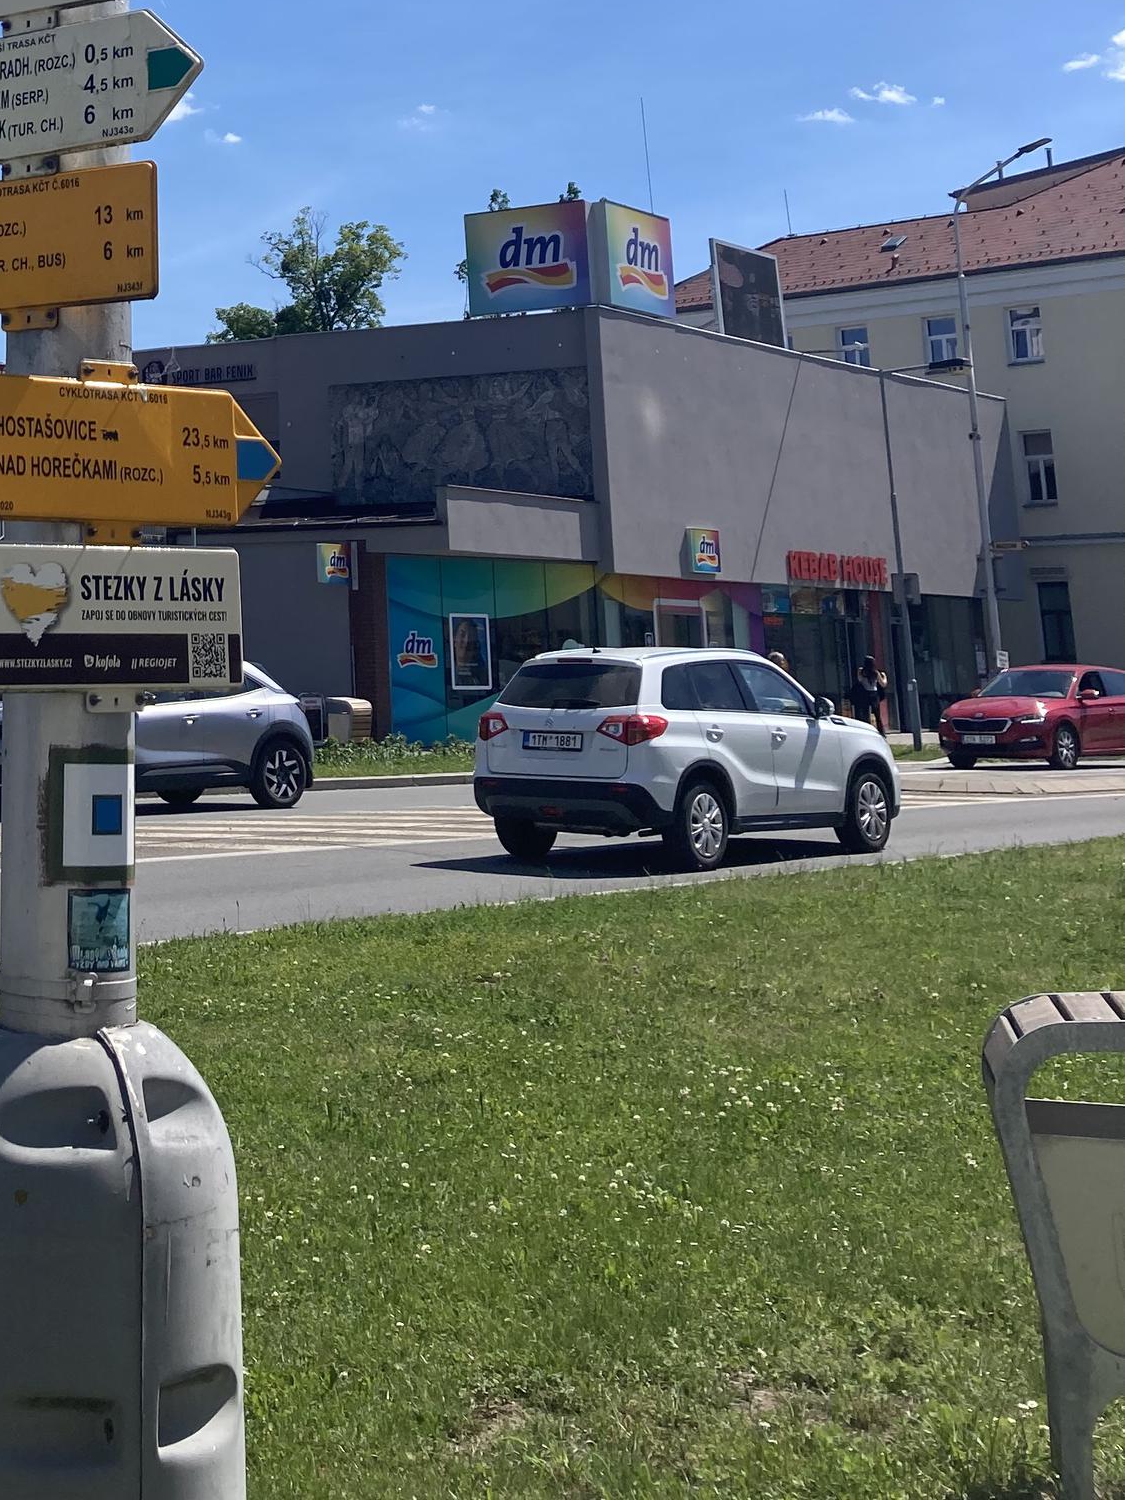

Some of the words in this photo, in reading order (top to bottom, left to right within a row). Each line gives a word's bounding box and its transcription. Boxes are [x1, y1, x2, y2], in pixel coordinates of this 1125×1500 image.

[7, 37, 36, 51] TRASA
[38, 33, 57, 45] KČT
[0, 57, 32, 81] RADH.
[34, 53, 76, 77] (ROZC.)
[84, 44, 108, 64] 0,5
[112, 44, 134, 59] km
[11, 88, 49, 110] (SERP.)
[83, 74, 108, 94] 4,5
[112, 74, 134, 90] km
[8, 122, 38, 142] (TUR.
[40, 116, 64, 135] CH.)
[84, 104, 95, 124] 6
[112, 106, 134, 121] km
[32, 180, 50, 193] KČT
[94, 205, 113, 225] 13
[126, 208, 143, 221] km
[38, 252, 66, 269] BUS)
[103, 241, 112, 260] 6
[126, 245, 144, 258] km
[499, 226, 561, 269] dm
[626, 227, 660, 272] dm
[172, 369, 201, 383] SPORT
[204, 367, 222, 380] BAR
[182, 427, 210, 448] 23,5
[213, 436, 229, 449] km
[31, 452, 118, 481] HOREČKAMI
[120, 466, 164, 486] (ROZC.)
[193, 464, 212, 486] 5,5
[214, 473, 231, 486] km
[699, 536, 714, 554] dm
[330, 552, 346, 567] dm
[788, 550, 838, 581] KEBAB
[842, 555, 888, 584] HOUSE
[80, 575, 147, 601] STEZKY
[154, 577, 165, 601] Z
[169, 569, 225, 602] LÁSKY
[81, 610, 103, 621] ZAPOJ
[128, 610, 156, 621] OBNOVY
[158, 608, 207, 622] TURISTICKÝCH
[405, 632, 432, 654] dm
[95, 654, 121, 671] kofola
[555, 735, 577, 747] 1881
